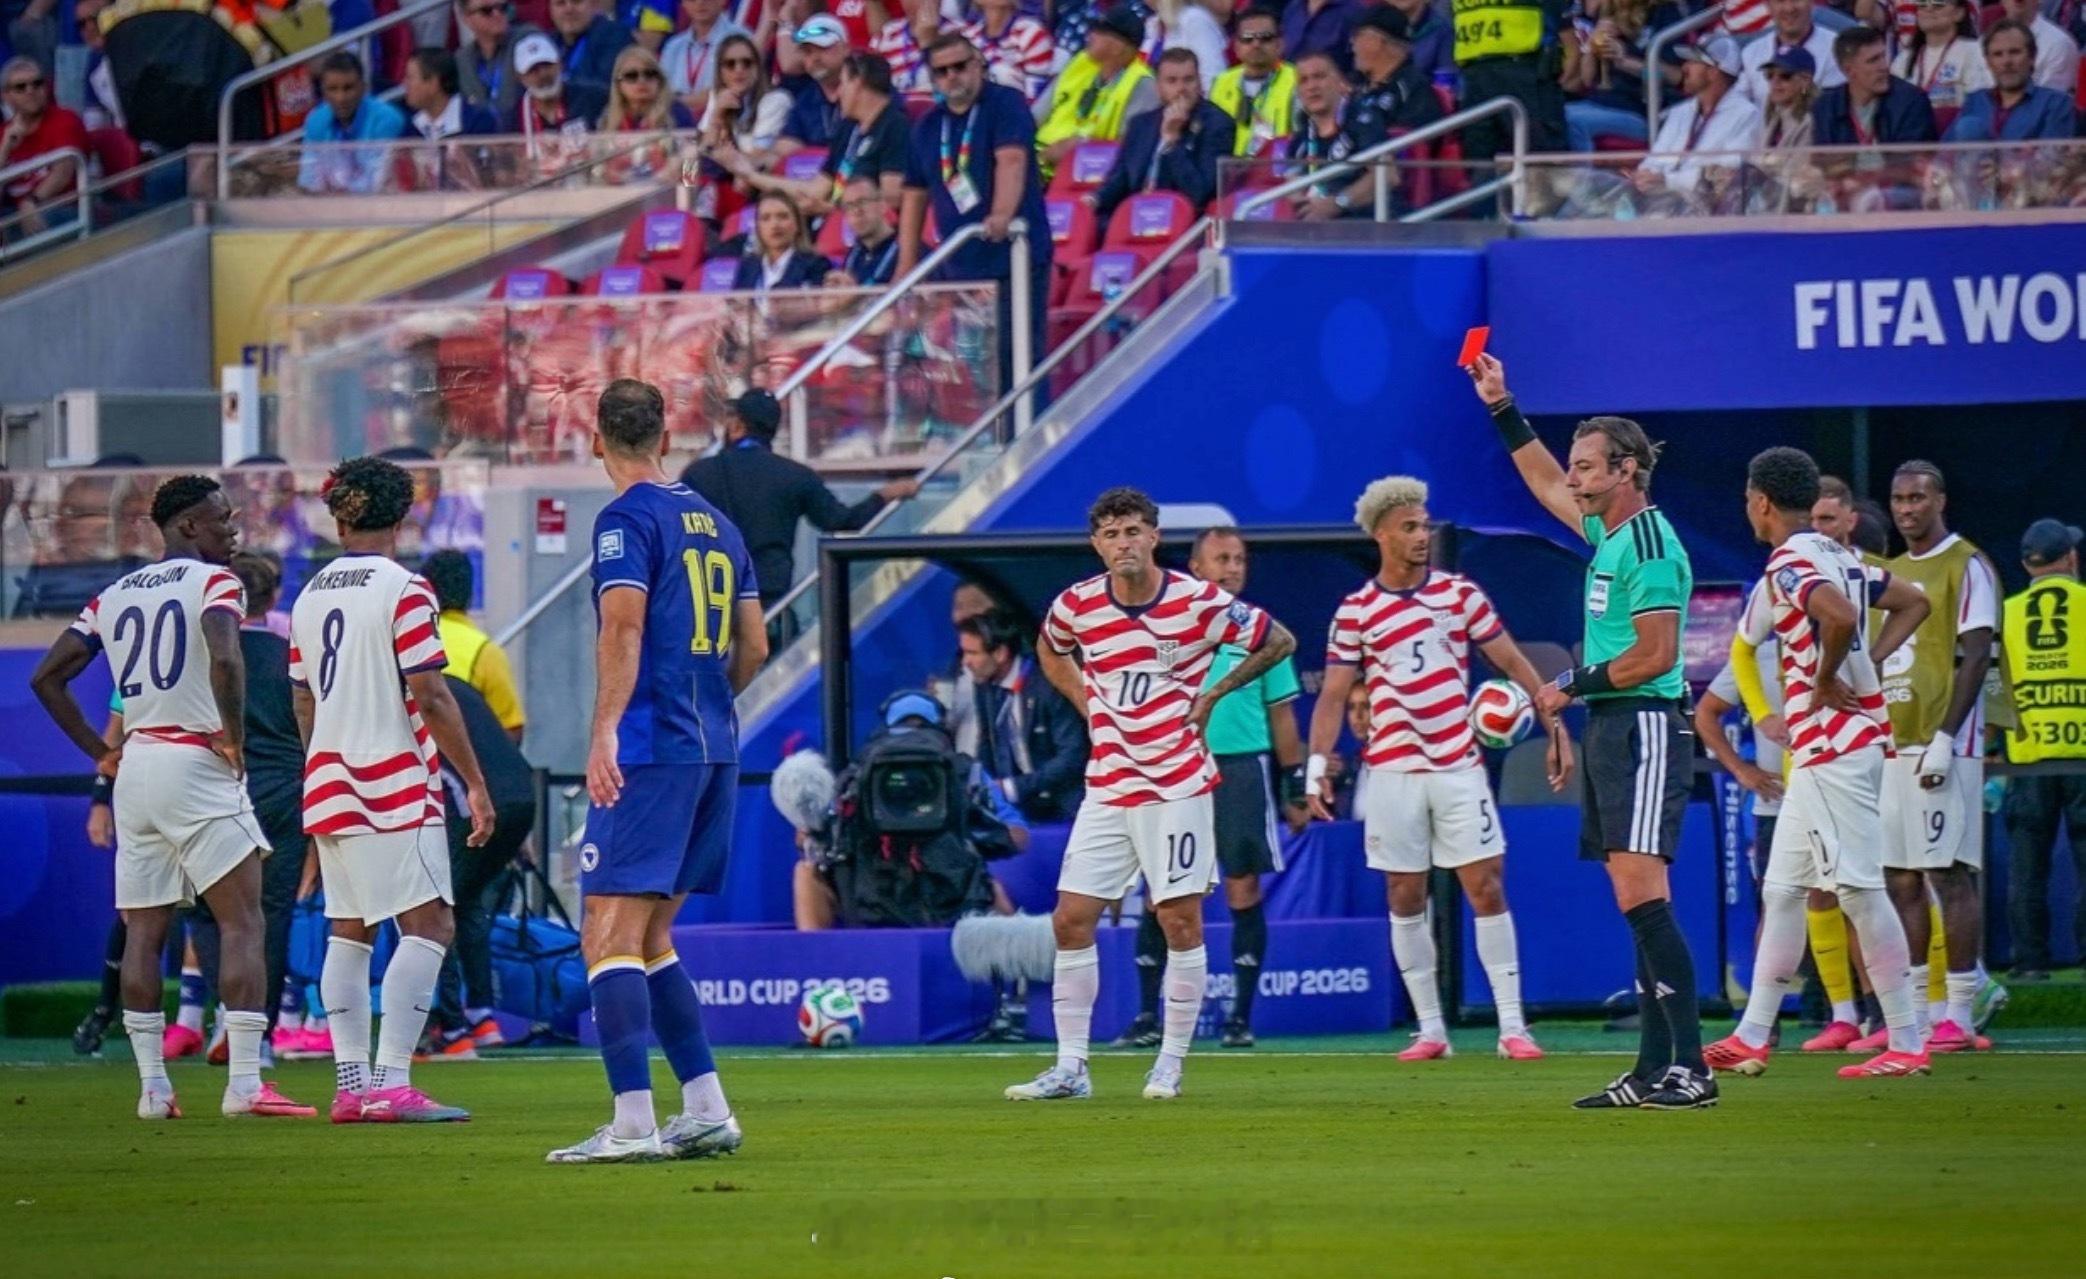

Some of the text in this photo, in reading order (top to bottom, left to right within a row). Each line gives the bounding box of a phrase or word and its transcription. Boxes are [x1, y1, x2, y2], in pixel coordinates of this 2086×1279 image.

[1794, 271, 2086, 350] FIFA WO
[683, 548, 734, 658] 19
[113, 598, 187, 699] 20
[319, 607, 345, 702] 8
[1410, 640, 1425, 674] 5
[2026, 660, 2069, 671] 2026
[1118, 671, 1151, 706] 10
[1480, 799, 1491, 832] 5
[1167, 831, 1196, 872] 10
[1725, 782, 1739, 905] Hisense
[749, 979, 799, 1005] CUP
[1258, 971, 1299, 997] CUP
[1300, 967, 1370, 994] 2026
